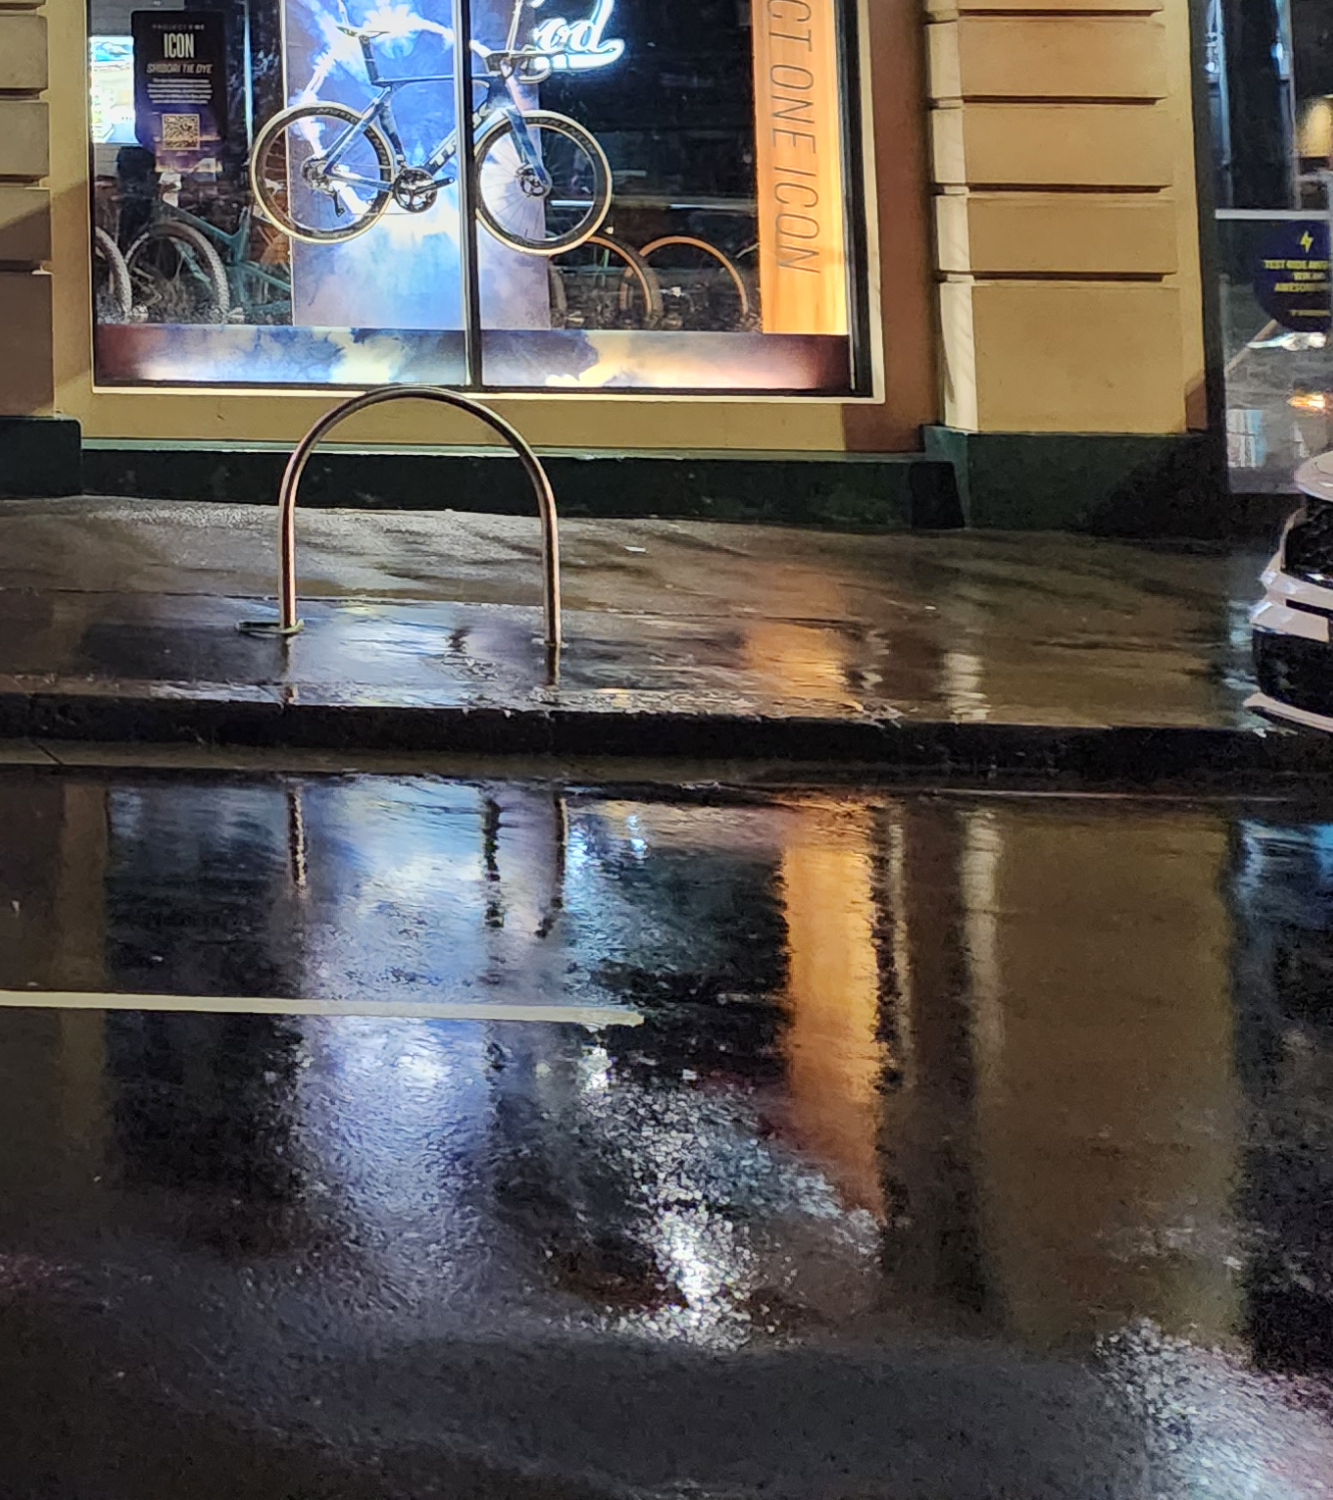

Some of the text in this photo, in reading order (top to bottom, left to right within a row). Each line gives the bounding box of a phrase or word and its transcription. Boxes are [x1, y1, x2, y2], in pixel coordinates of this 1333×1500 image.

[163, 33, 195, 58] ICON
[195, 63, 213, 74] DYE
[770, 63, 817, 155] ONE
[773, 164, 822, 275] ICON
